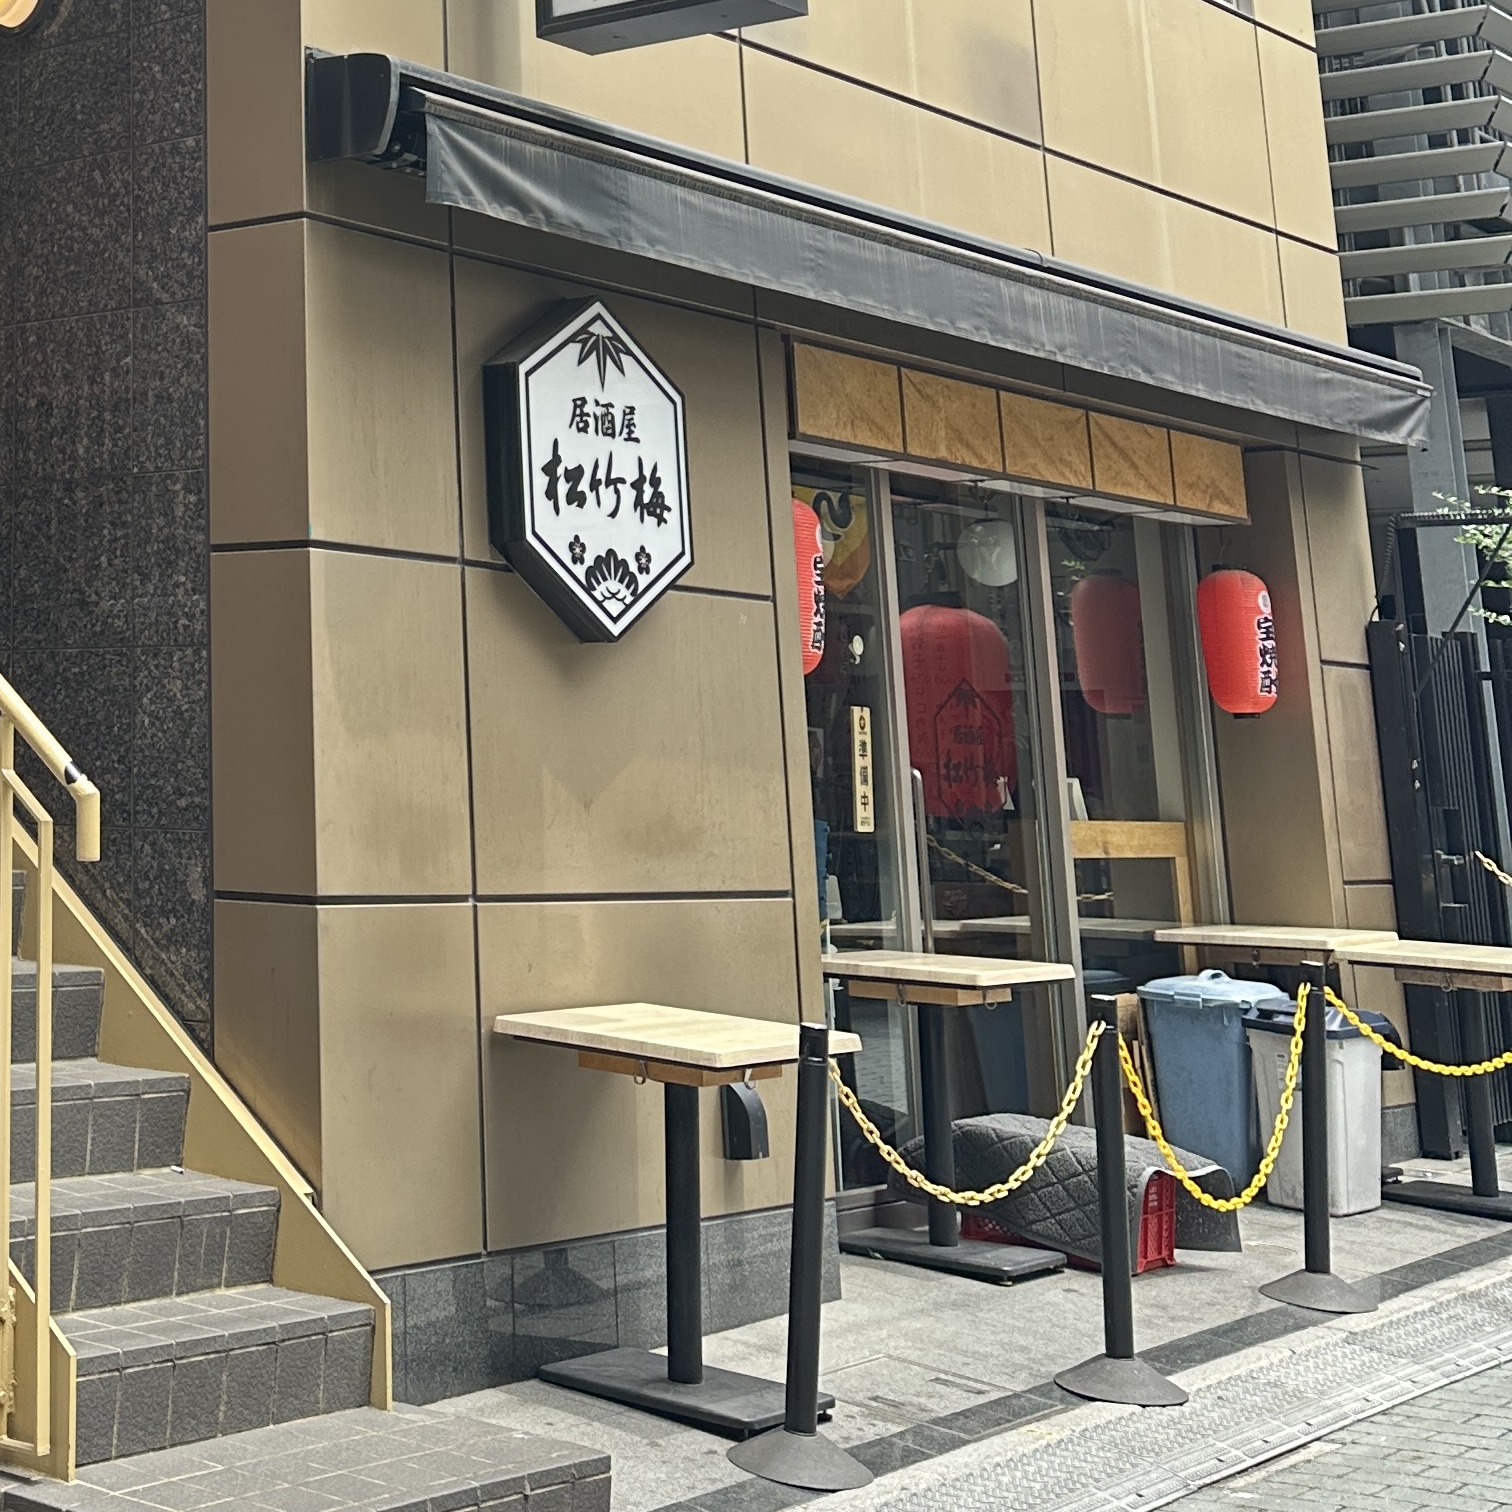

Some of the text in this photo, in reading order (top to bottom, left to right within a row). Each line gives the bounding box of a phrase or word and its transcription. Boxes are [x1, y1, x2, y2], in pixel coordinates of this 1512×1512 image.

[568, 396, 641, 444] 居酒屋
[541, 437, 672, 528] 松竹梅
